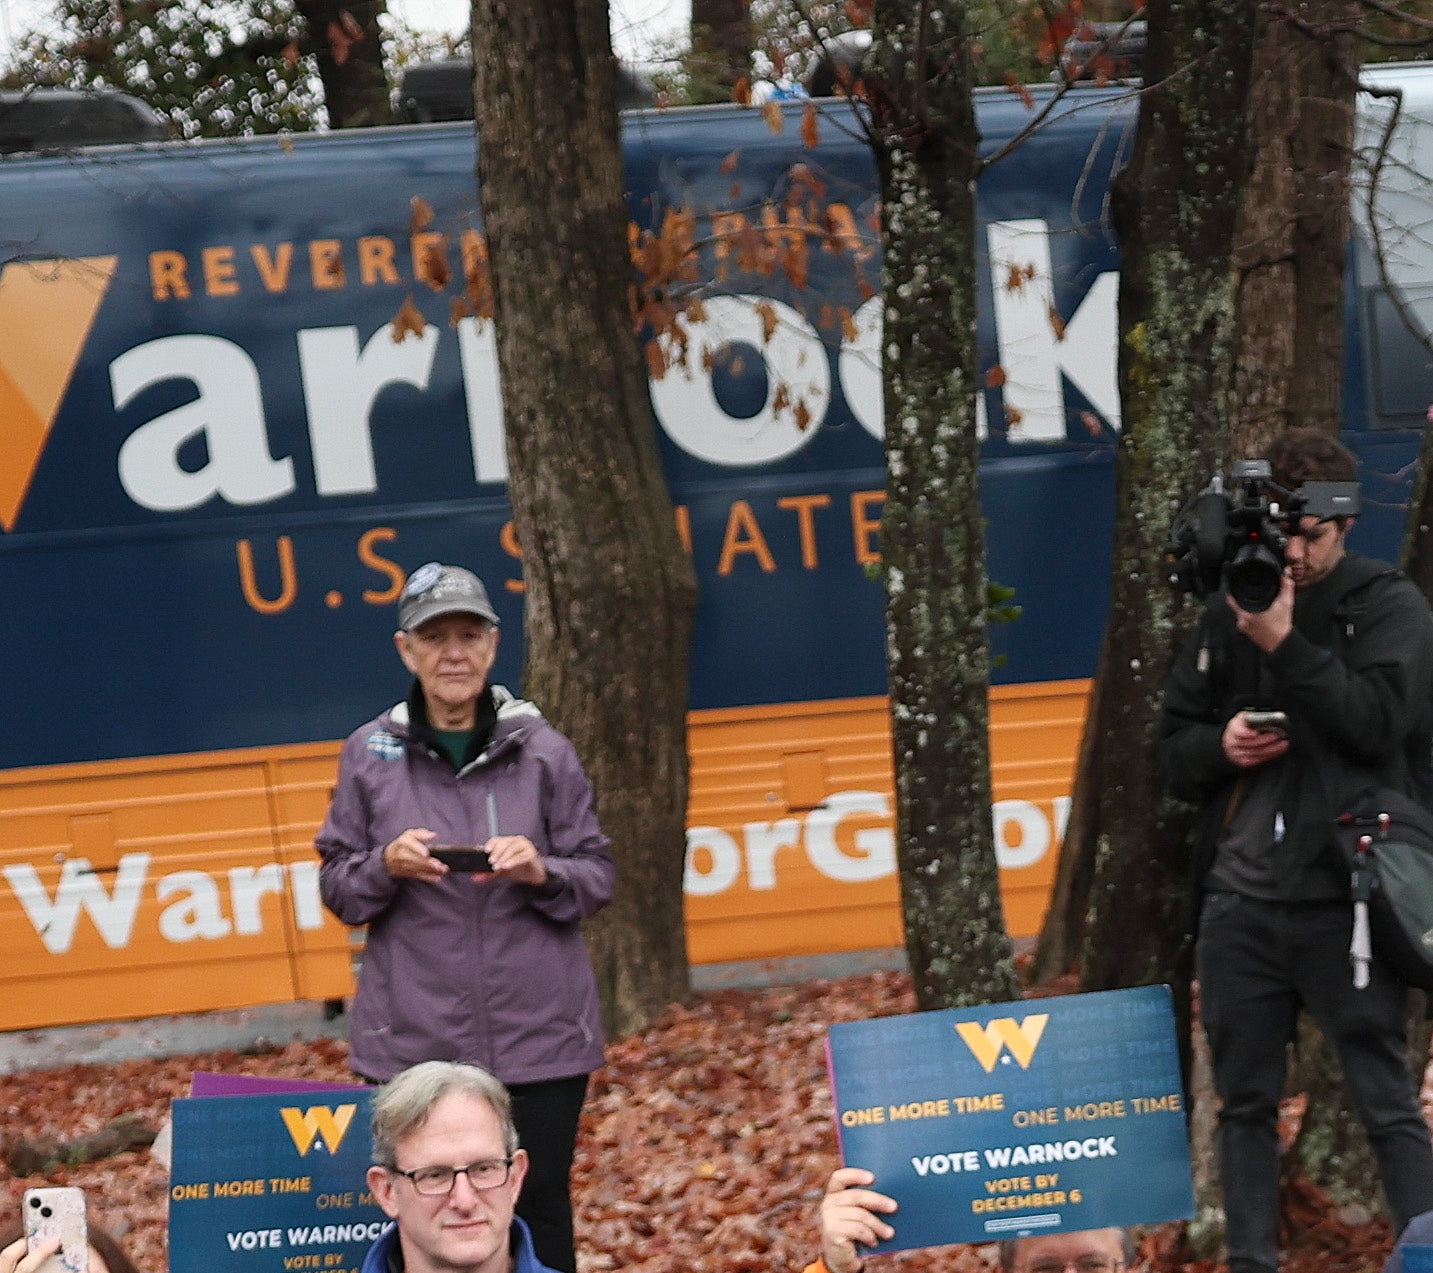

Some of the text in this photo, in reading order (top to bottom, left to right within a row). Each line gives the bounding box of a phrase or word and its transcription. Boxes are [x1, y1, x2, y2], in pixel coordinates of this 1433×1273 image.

[843, 1094, 1004, 1126] ONE MORE TIME
[1013, 1094, 1182, 1126] ONE MORE TIME
[912, 1137, 1117, 1177] VOTE WARNOCK
[172, 1176, 310, 1200] ONE MORE TIME
[985, 1173, 1058, 1194] VOTE BY
[972, 1192, 1065, 1212] DECEMBER
[227, 1227, 282, 1252] VOTE
[283, 1254, 343, 1270] VOTE BY
